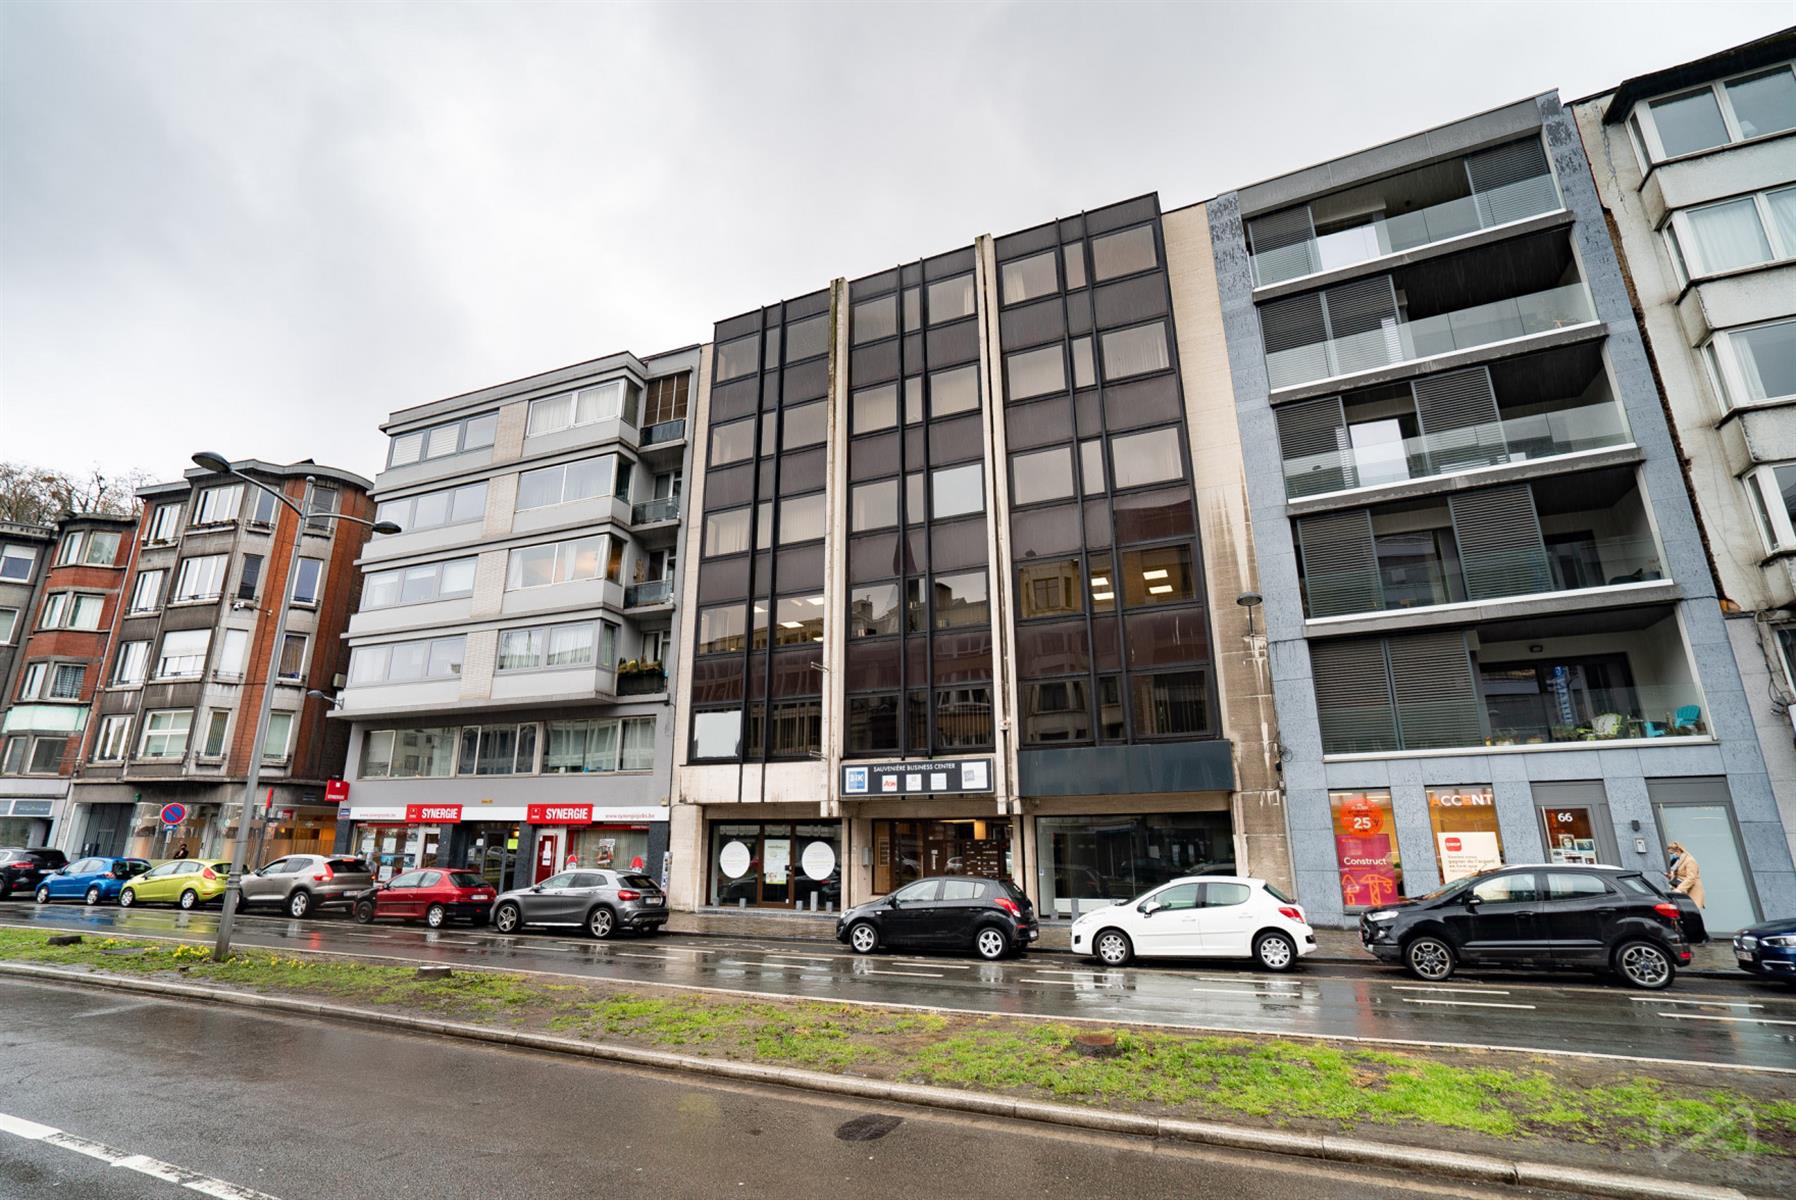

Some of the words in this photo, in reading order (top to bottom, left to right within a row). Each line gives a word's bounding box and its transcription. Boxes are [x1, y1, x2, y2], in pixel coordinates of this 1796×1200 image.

[907, 763, 934, 771] BUSINESS
[934, 762, 956, 770] CENTER
[1429, 794, 1493, 807] ACCENT
[421, 807, 459, 819] SYNERGIE
[545, 807, 589, 820] SYNERGIE
[1557, 812, 1574, 823] 66
[1353, 816, 1372, 830] 25
[1343, 856, 1388, 866] Construct
